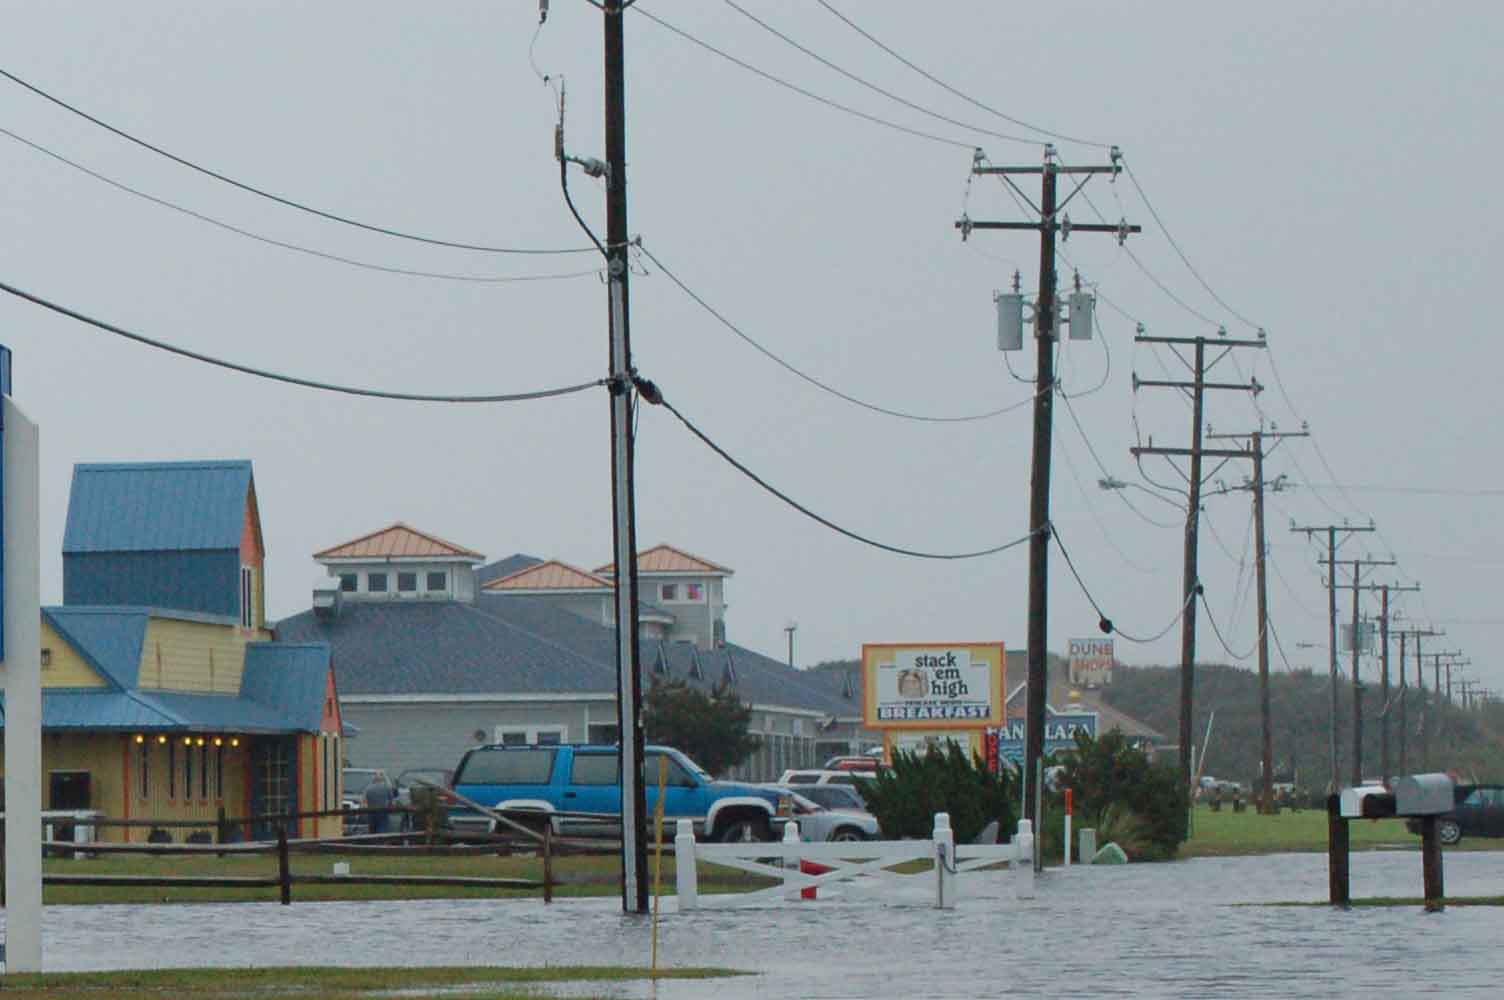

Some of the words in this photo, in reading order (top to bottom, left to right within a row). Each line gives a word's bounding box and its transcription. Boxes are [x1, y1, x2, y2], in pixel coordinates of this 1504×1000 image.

[914, 651, 957, 668] stack
[930, 679, 969, 699] high
[879, 705, 988, 720] BREAKFAST
